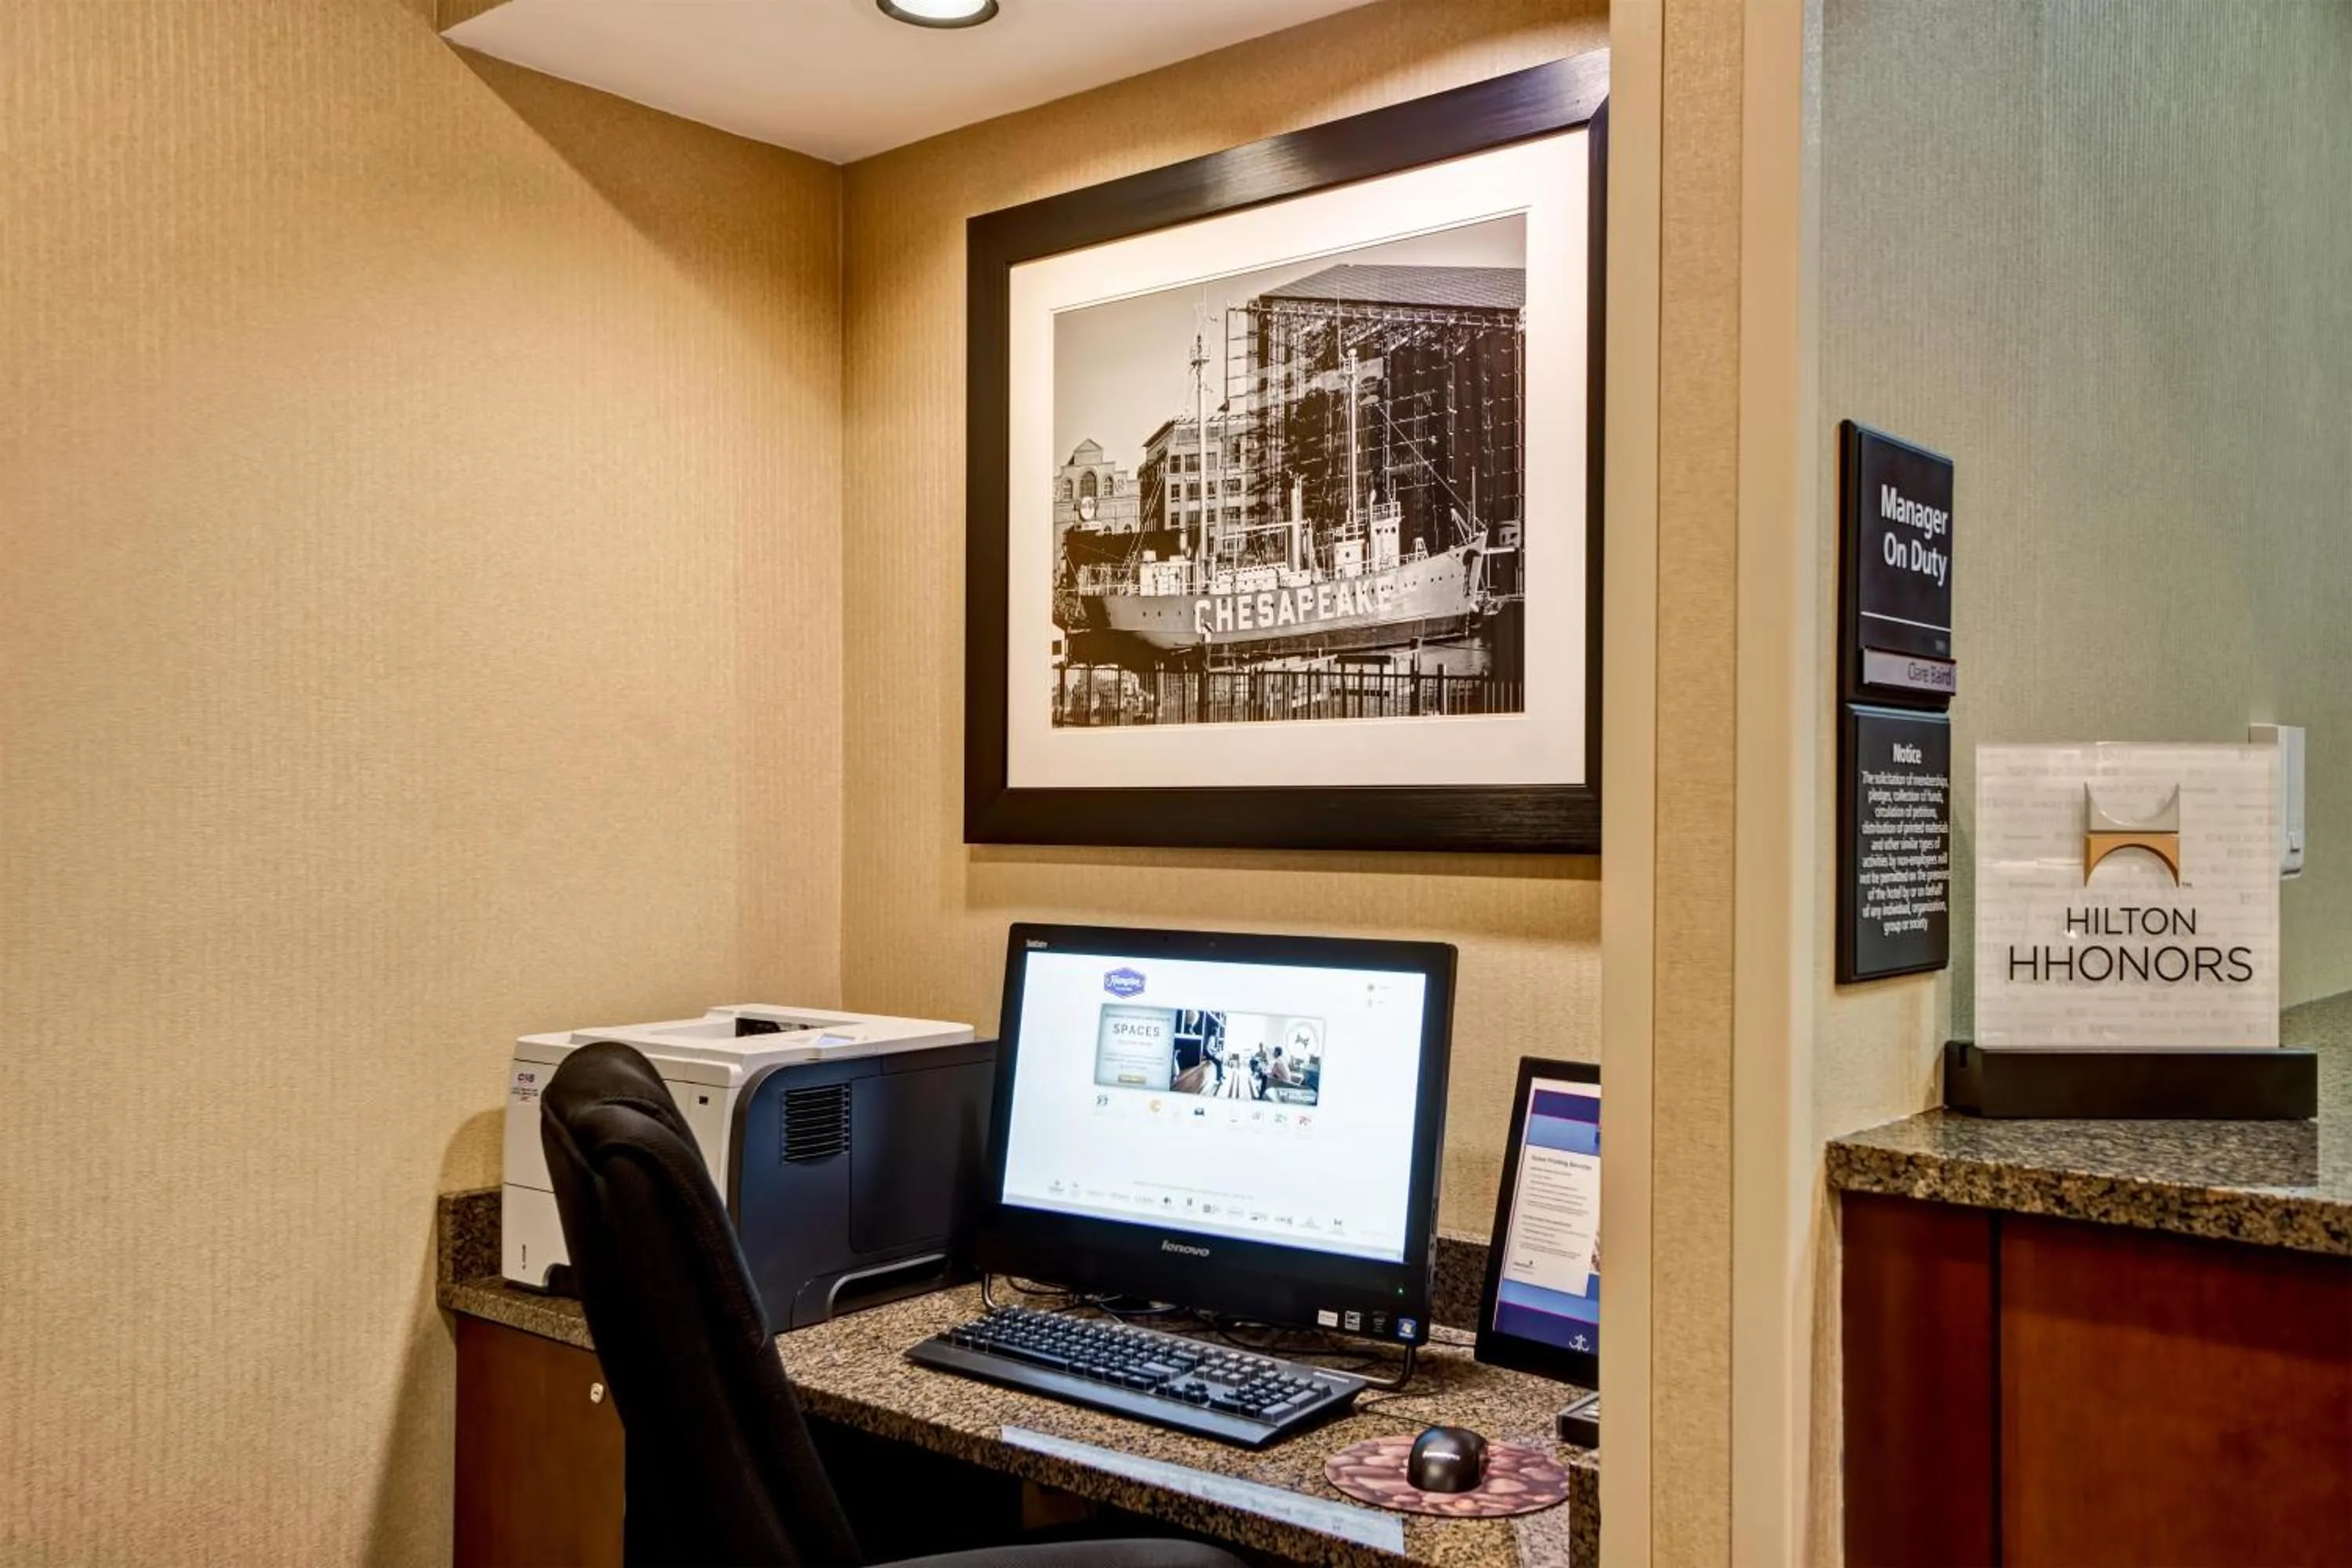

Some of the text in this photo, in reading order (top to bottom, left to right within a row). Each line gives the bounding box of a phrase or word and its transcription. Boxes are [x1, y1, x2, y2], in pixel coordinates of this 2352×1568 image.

[1881, 484, 1948, 539] Manager
[1884, 531, 1948, 587] On Duty
[1193, 575, 1393, 636] CHESAPEAKE
[1893, 742, 1922, 764] Notice
[2067, 907, 2197, 935] HILTON
[2009, 946, 2253, 983] HHONORS
[1112, 1022, 1161, 1038] SPACES
[1160, 1239, 1210, 1258] lenovo
